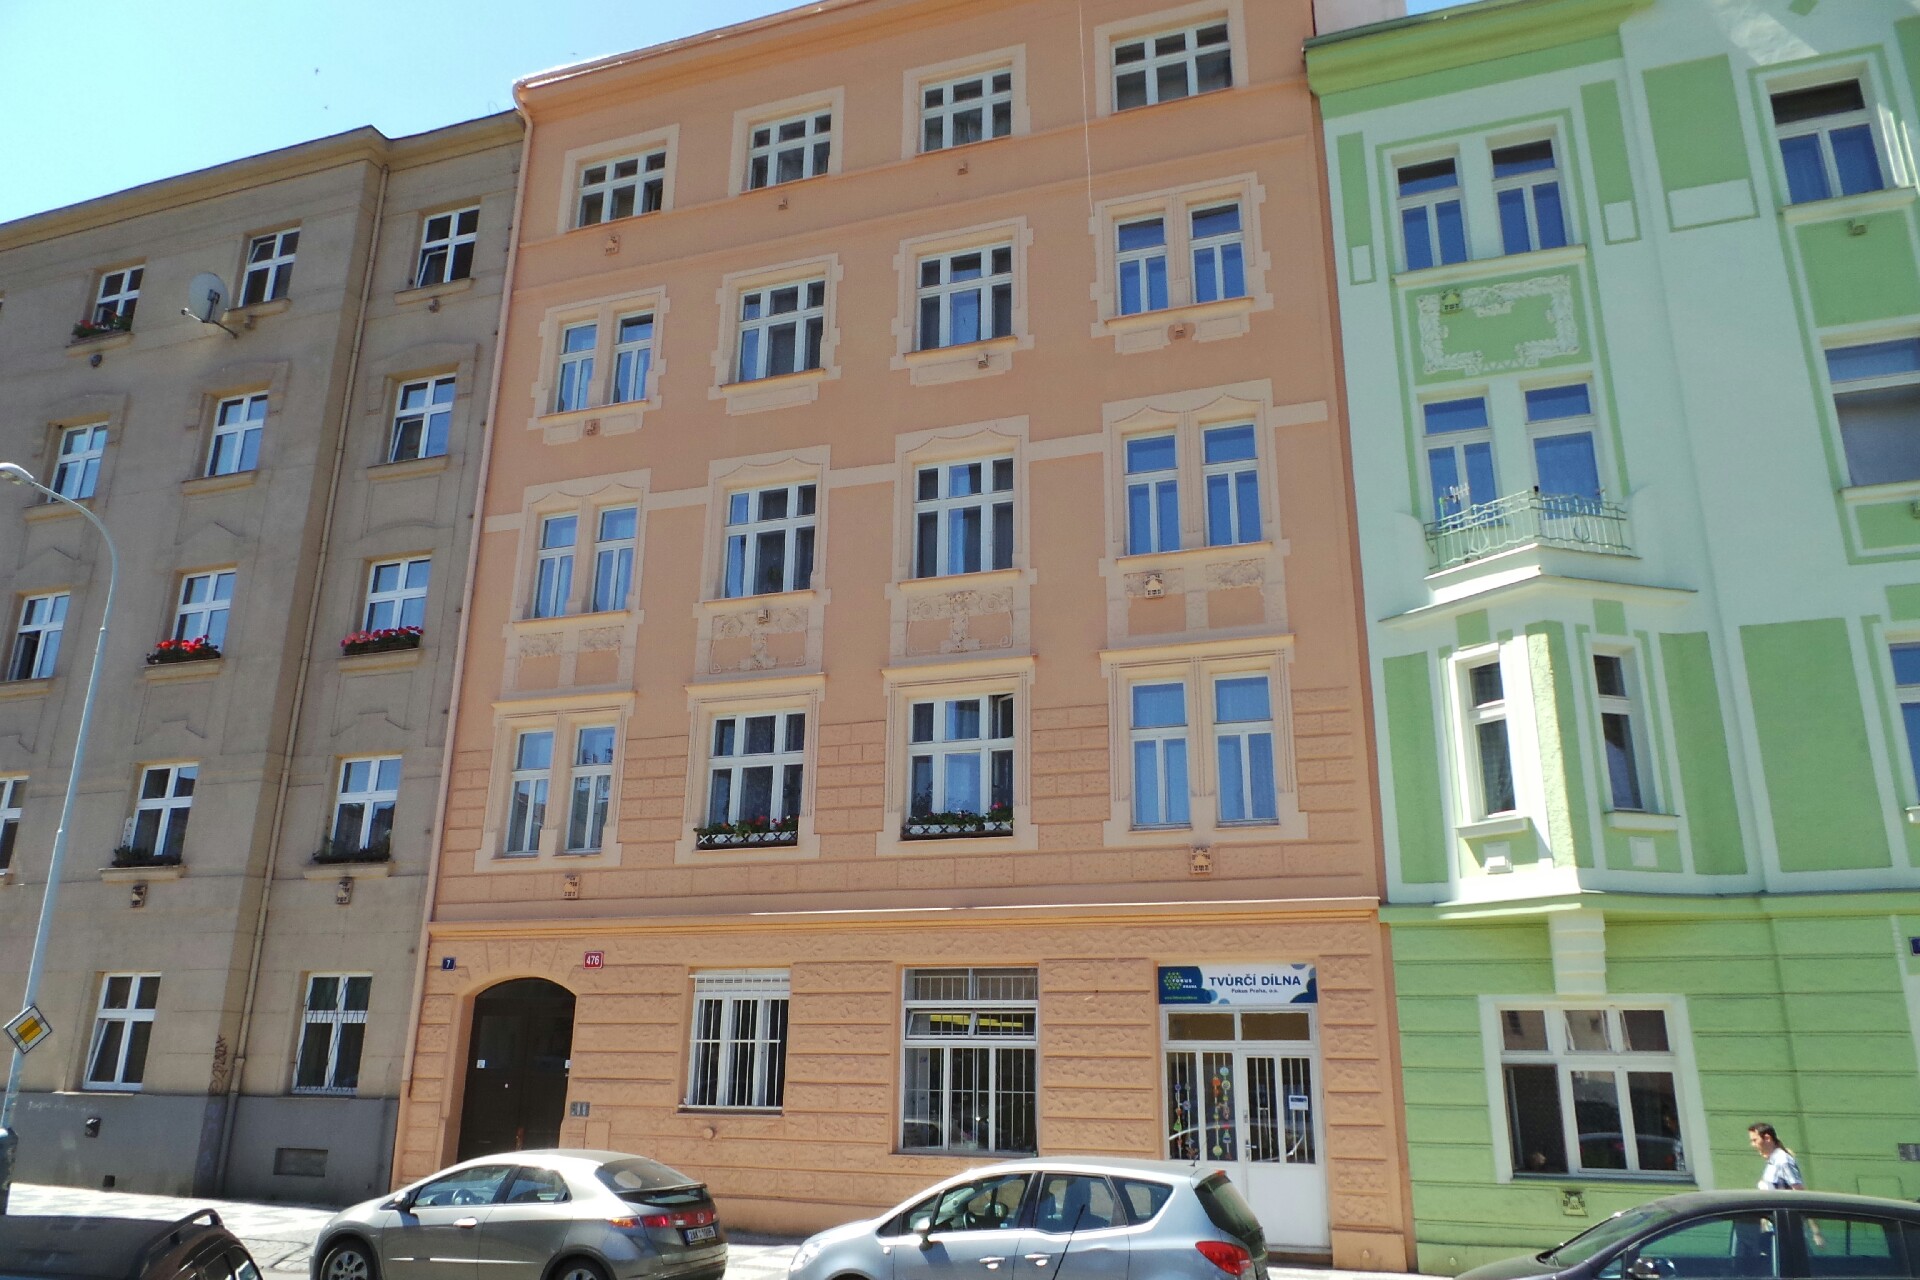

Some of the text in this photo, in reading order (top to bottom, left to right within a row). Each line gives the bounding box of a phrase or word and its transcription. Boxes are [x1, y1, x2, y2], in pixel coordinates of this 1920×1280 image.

[446, 959, 451, 969] 7
[586, 955, 600, 965] 476
[1209, 973, 1301, 986] TVŮRČÍ DÍLNA
